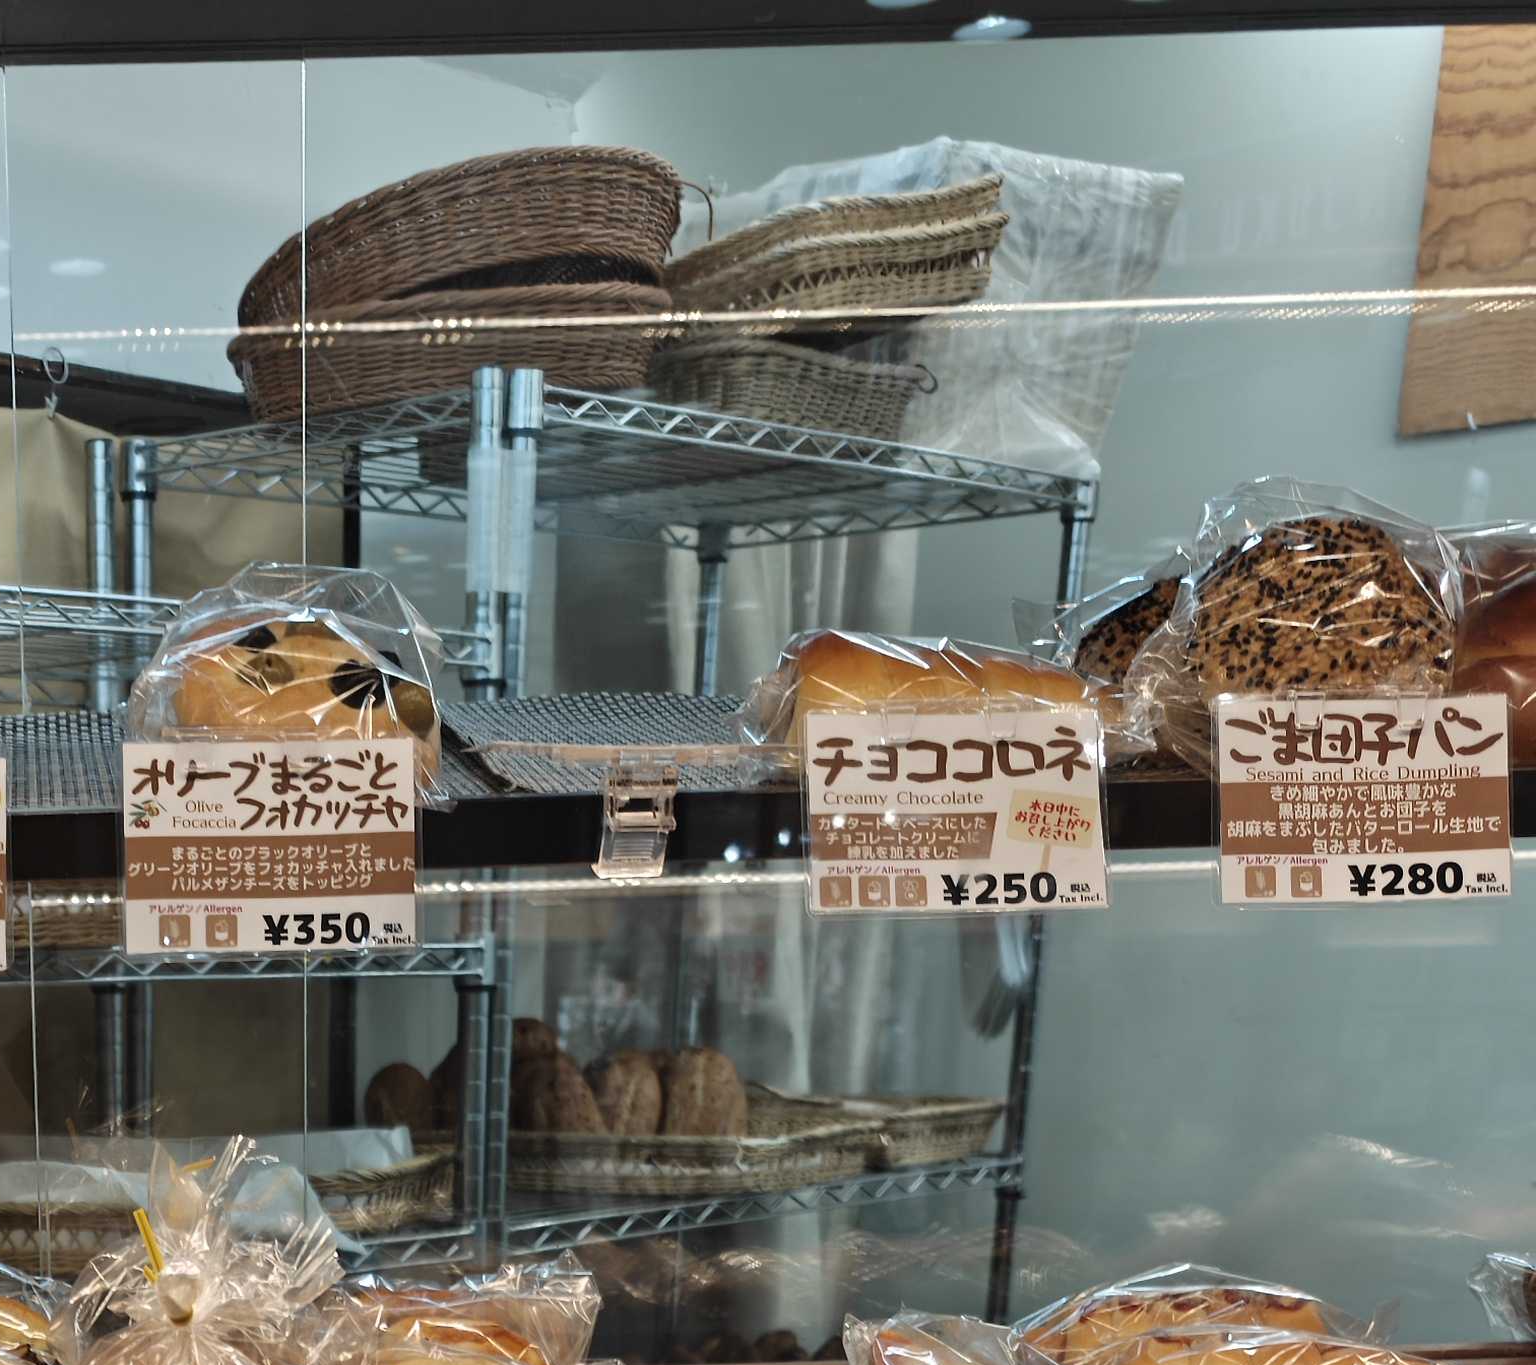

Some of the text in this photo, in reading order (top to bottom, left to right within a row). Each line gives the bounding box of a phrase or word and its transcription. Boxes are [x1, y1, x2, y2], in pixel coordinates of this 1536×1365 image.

[1225, 707, 1503, 765] ごま団子パン
[813, 726, 1091, 786] チョココロネ
[132, 750, 397, 797] オリーブまるごと
[1246, 764, 1480, 782] Sesami and Rice Dumpling
[185, 800, 224, 813] Olive
[237, 794, 408, 830] フォカッチャ
[824, 791, 984, 808] Creamy Chocolate
[172, 816, 237, 829] Focaccia
[1227, 815, 1500, 837] 胡麻をまぶしたバターロール生地で
[172, 844, 371, 860] まるごとのブラックオリーブと
[942, 873, 1057, 905] ¥250
[1348, 862, 1463, 896] ¥280
[263, 912, 370, 945] ¥350
